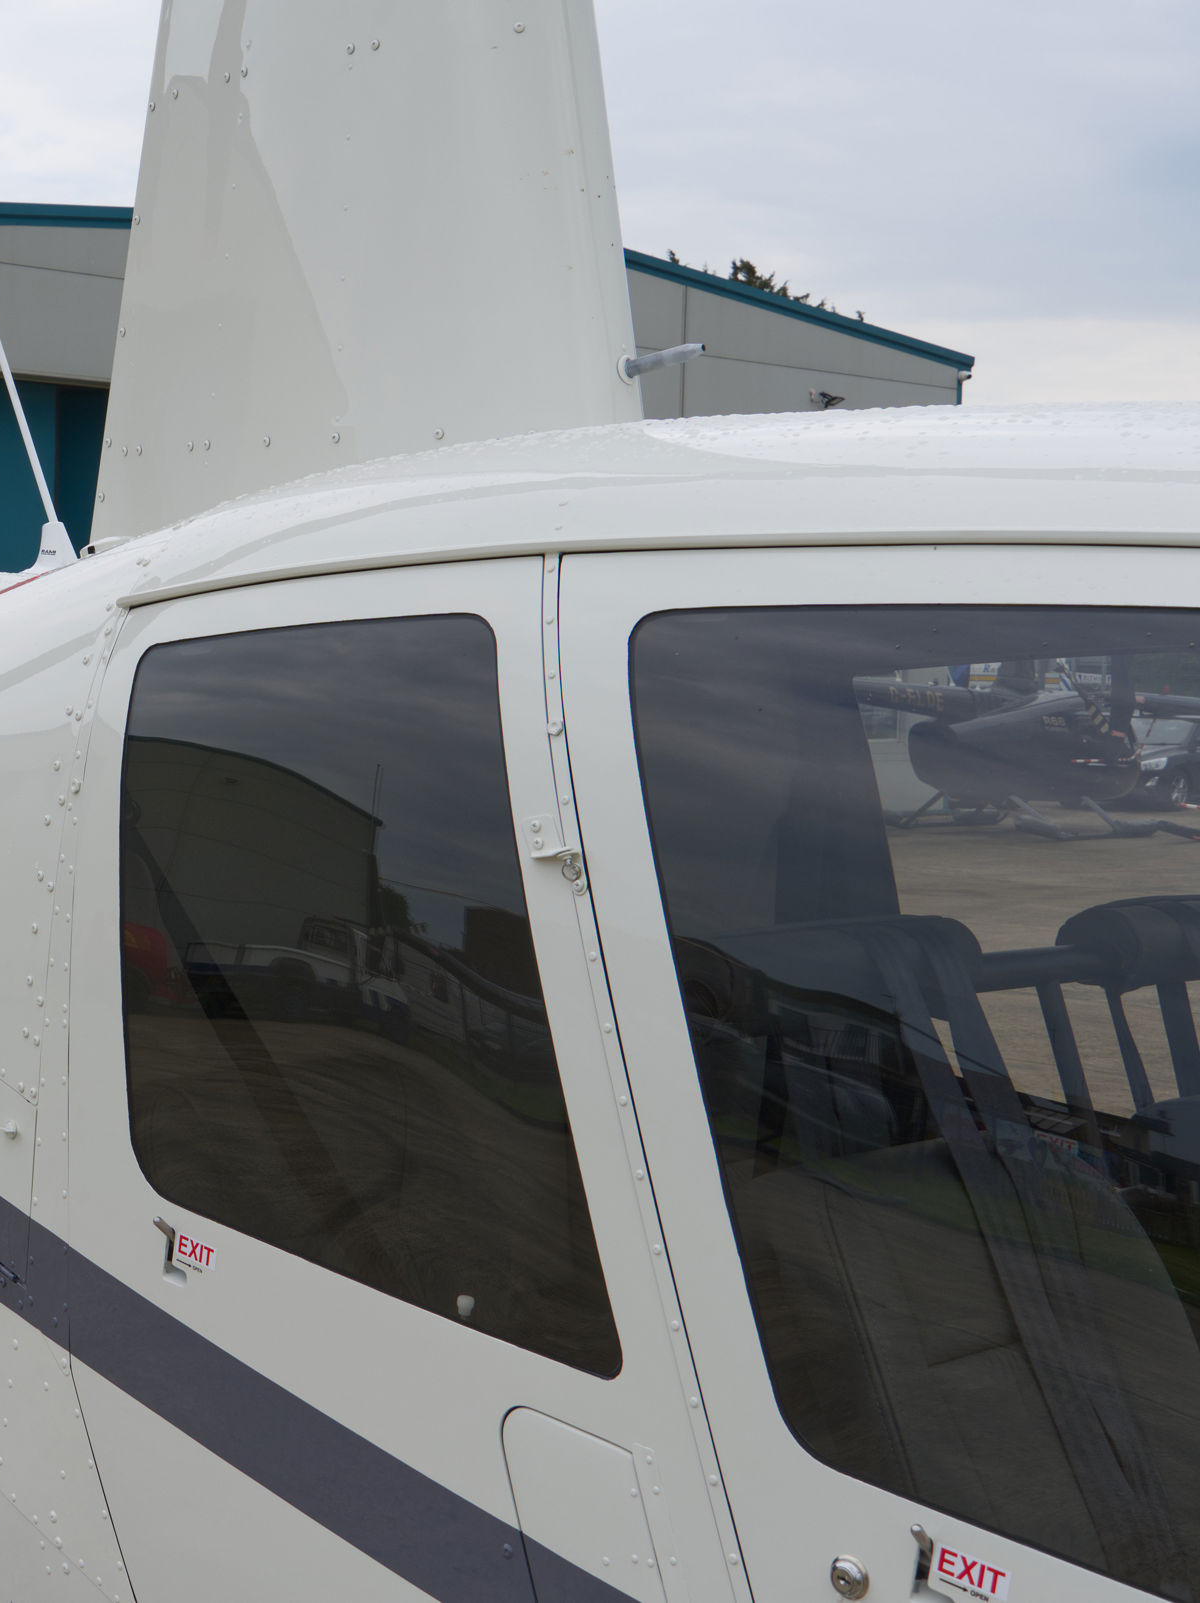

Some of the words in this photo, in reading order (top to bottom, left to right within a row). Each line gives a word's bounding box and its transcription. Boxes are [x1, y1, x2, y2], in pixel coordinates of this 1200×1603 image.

[178, 1234, 215, 1266] EXIT
[937, 1547, 1006, 1595] EXIT
[970, 1590, 990, 1602] OPEN
